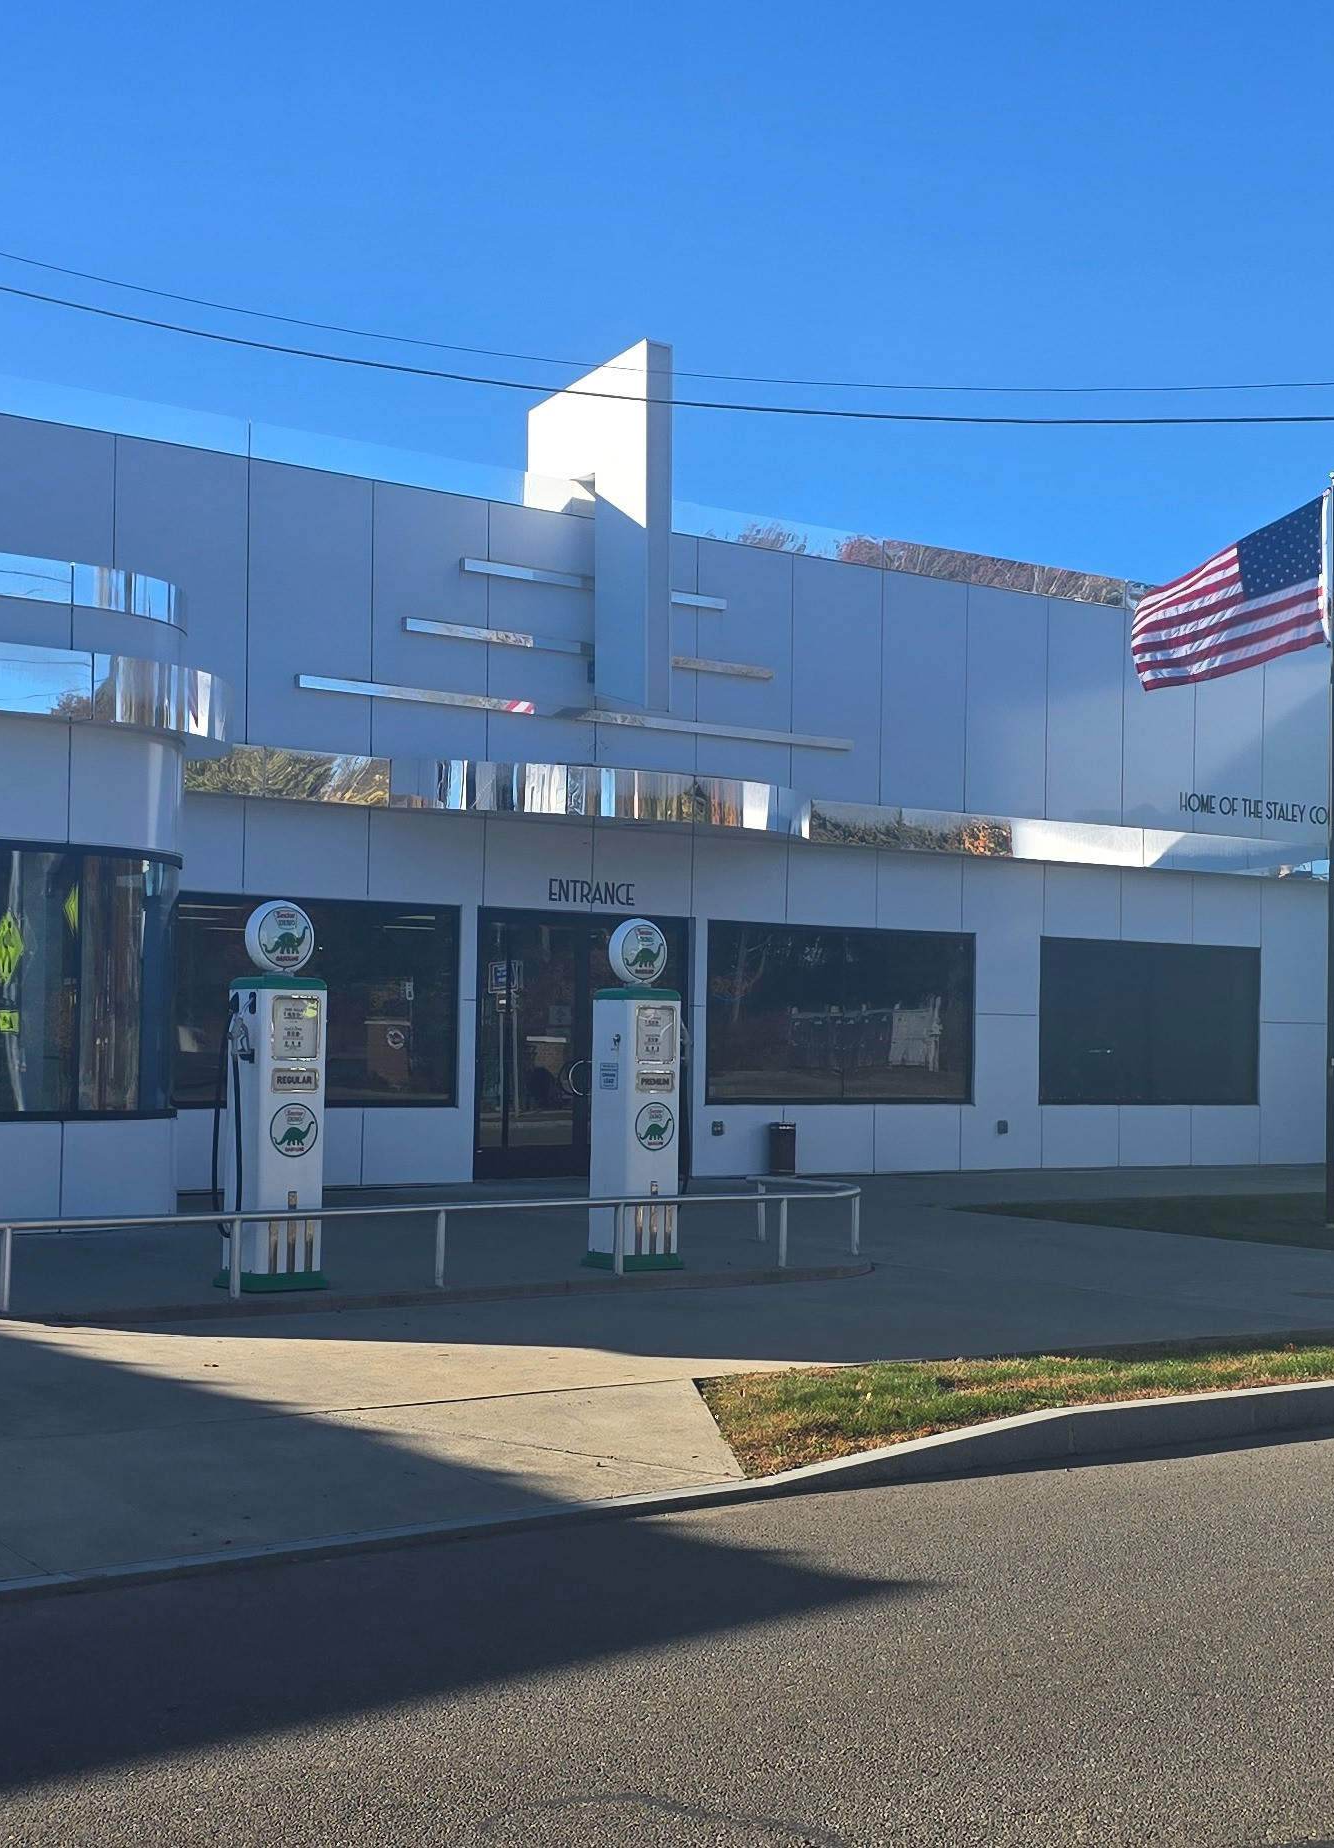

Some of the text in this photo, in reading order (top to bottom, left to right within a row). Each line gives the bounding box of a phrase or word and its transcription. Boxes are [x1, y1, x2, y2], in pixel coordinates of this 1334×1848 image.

[1179, 791, 1216, 815] HOME
[1219, 796, 1238, 816] OF
[1241, 798, 1262, 819] THE
[1265, 801, 1306, 823] STALEY
[548, 877, 635, 907] ENTRANCE
[276, 1075, 313, 1085] REGULAR
[640, 1077, 670, 1086] PREMIUM
